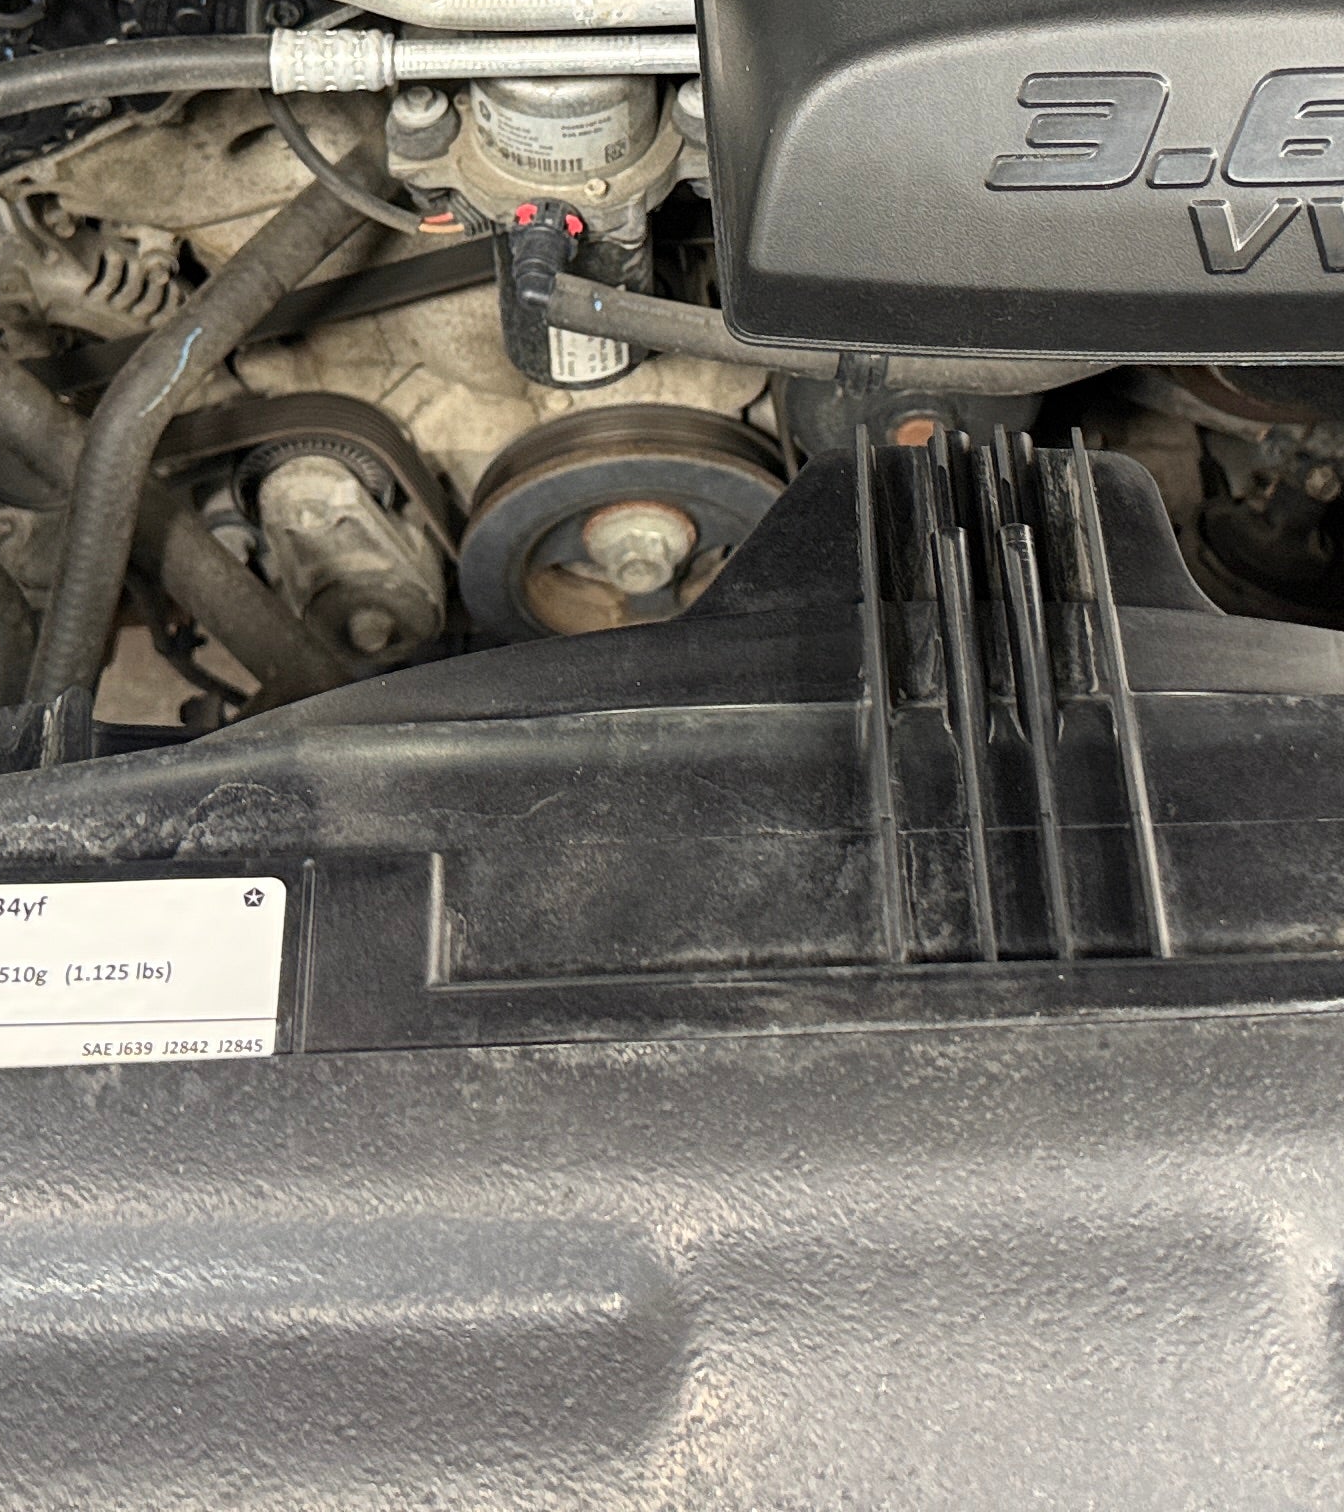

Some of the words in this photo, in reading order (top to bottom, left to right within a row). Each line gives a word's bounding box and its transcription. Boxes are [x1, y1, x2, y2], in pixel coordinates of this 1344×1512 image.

[65, 963, 130, 987] (1.125
[135, 960, 173, 986] lbs)
[82, 1041, 113, 1057] SAE
[115, 1040, 154, 1056] J639
[162, 1039, 209, 1055] J2842
[217, 1038, 264, 1054] J2845
